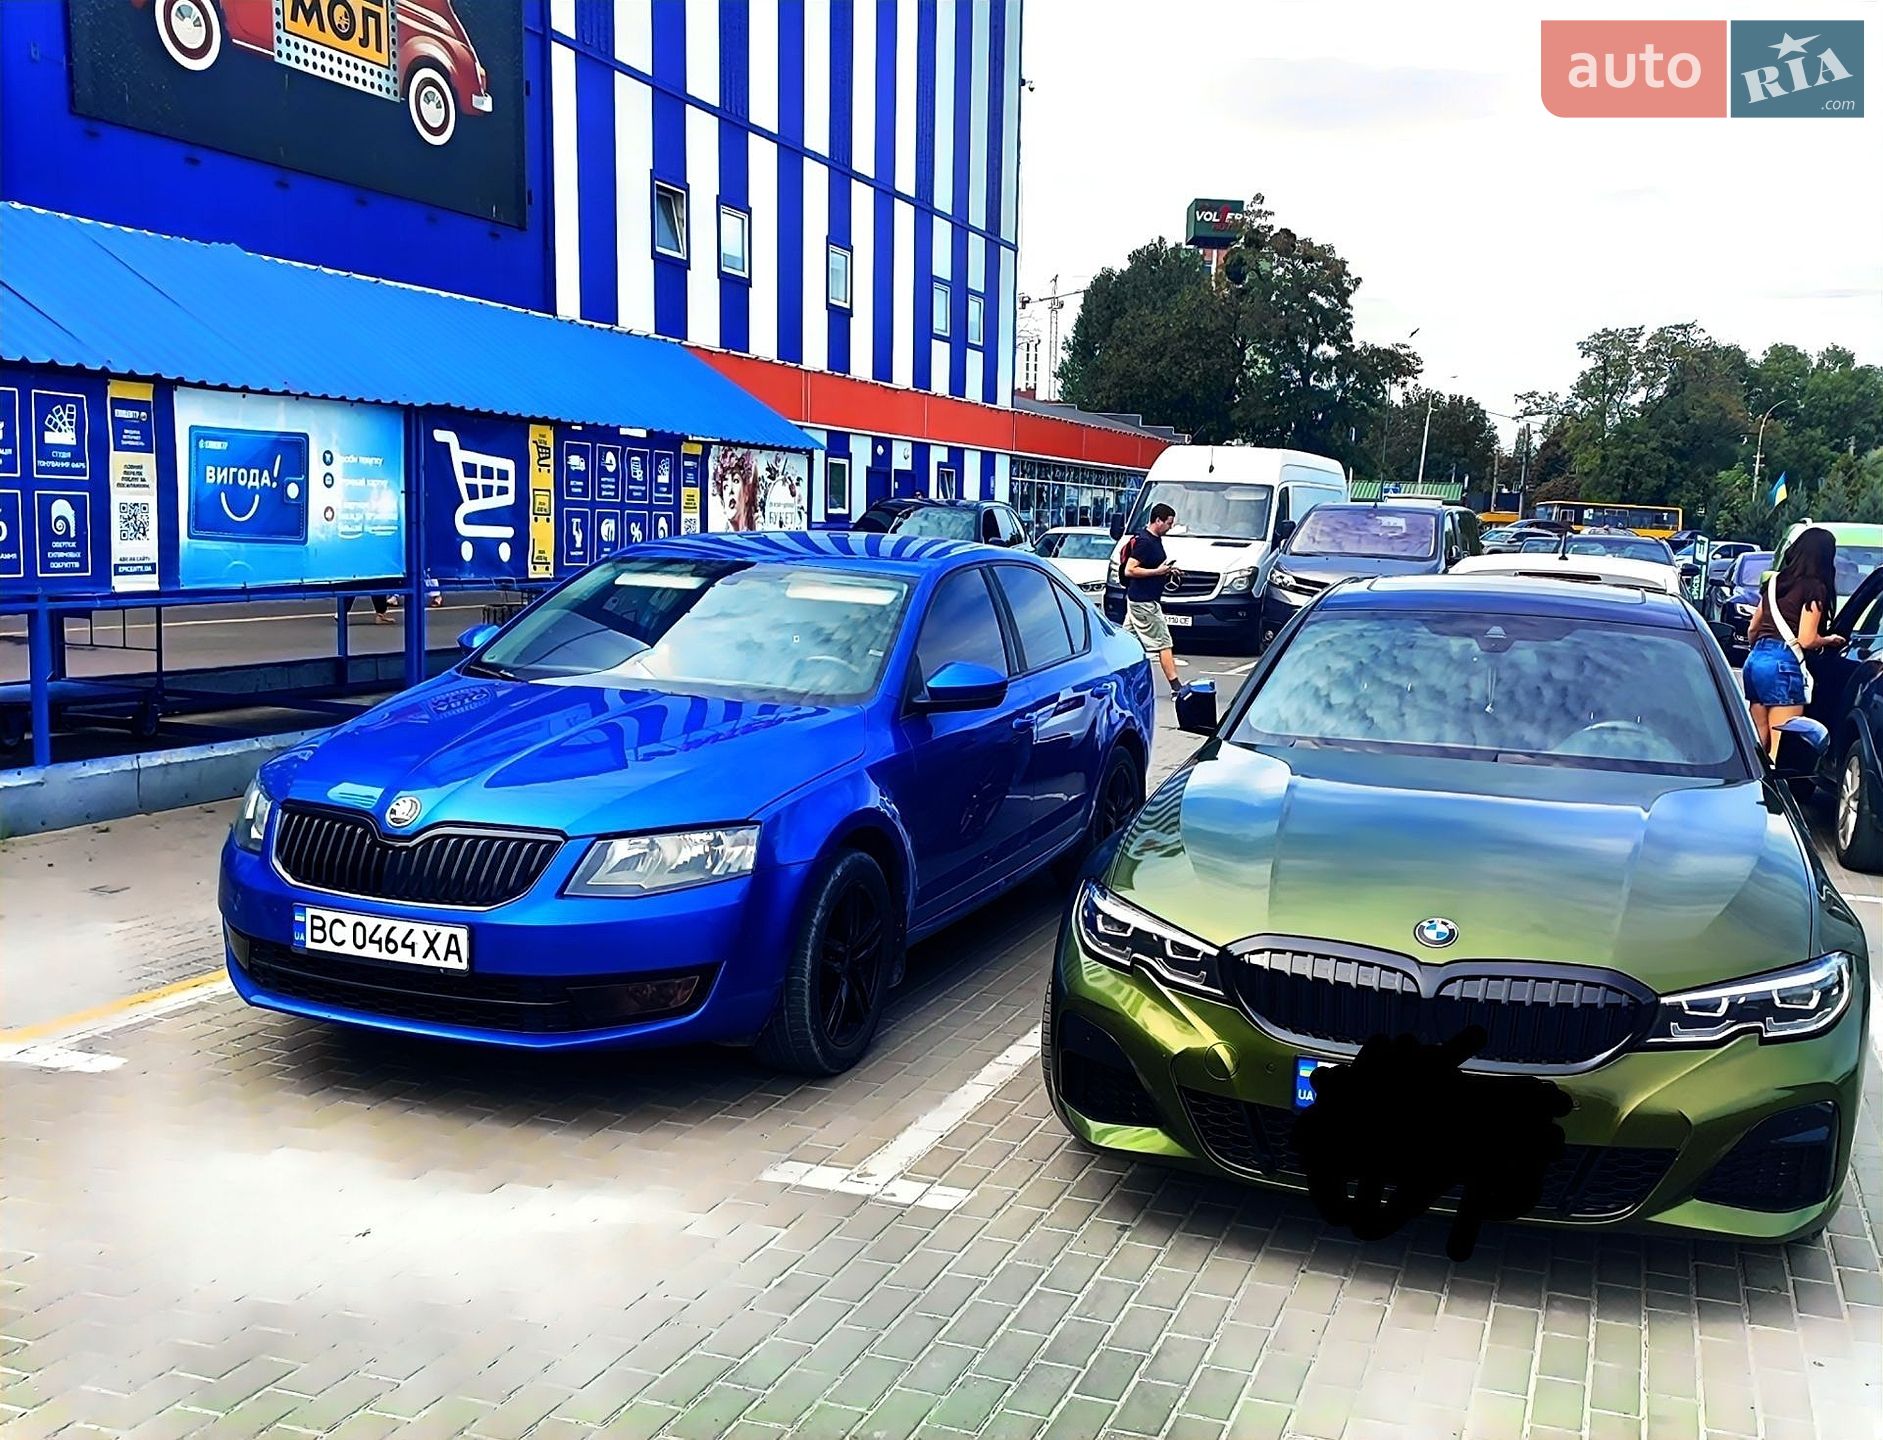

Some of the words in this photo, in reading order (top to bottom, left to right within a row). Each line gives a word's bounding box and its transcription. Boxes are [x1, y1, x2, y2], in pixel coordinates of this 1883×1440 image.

[290, 0, 383, 54] МОЛ
[1195, 209, 1244, 223] VOLER
[205, 454, 281, 490] ВИГОДА!
[294, 931, 305, 942] UA
[1298, 1089, 1314, 1101] UA
